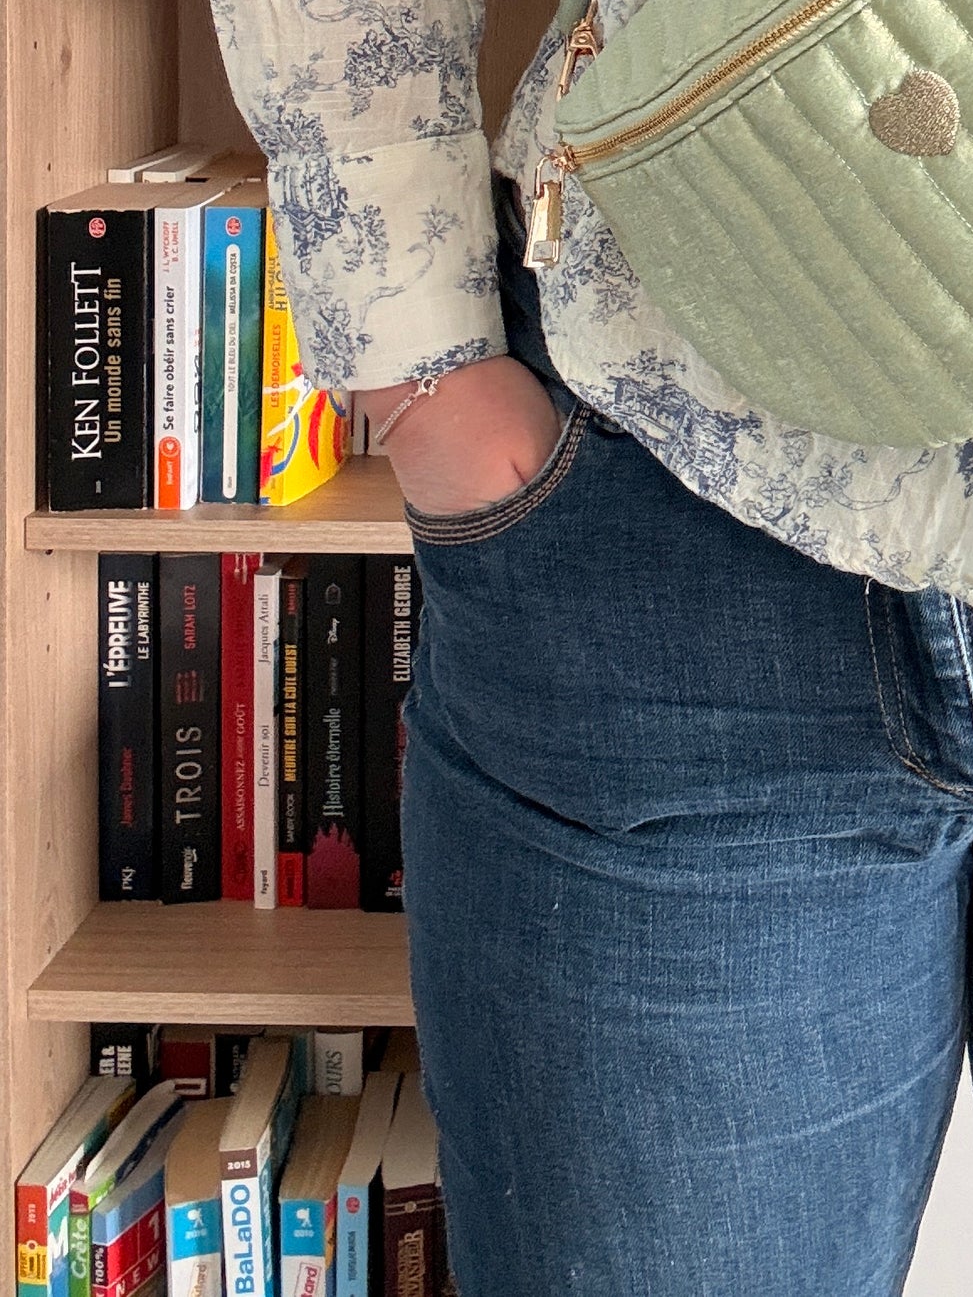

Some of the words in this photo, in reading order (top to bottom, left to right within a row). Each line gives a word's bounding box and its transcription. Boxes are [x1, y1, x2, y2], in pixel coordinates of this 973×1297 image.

[103, 277, 122, 301] fin
[164, 285, 175, 314] crier
[70, 261, 102, 387] FOLLETT
[108, 307, 122, 347] sans
[165, 317, 175, 345] sans
[162, 348, 175, 382] obéir
[270, 324, 281, 388] DEMOISELLES
[104, 355, 122, 413] monde
[162, 383, 175, 413] faire
[271, 389, 281, 408] LES
[71, 400, 102, 461] KEN
[105, 419, 122, 443] Un
[162, 415, 174, 431] Se
[257, 593, 269, 623] Attali
[393, 565, 412, 617] GEORGE
[137, 582, 150, 644] LABYRINTHE
[327, 617, 340, 644] Disney
[103, 580, 132, 688] L'ÉPREUVE
[137, 645, 149, 660] LE
[258, 624, 272, 664] Jacques
[392, 620, 411, 682] ELIZABETH
[234, 702, 246, 734] GOÛT
[322, 708, 345, 761] éternelle
[175, 726, 203, 824] TROIS
[258, 742, 270, 788] Devenir
[235, 759, 246, 831] ASSAISONNEZ
[322, 764, 345, 817] Histoire
[226, 1160, 251, 1171] 2015
[230, 1183, 256, 1296] BaLaDO
